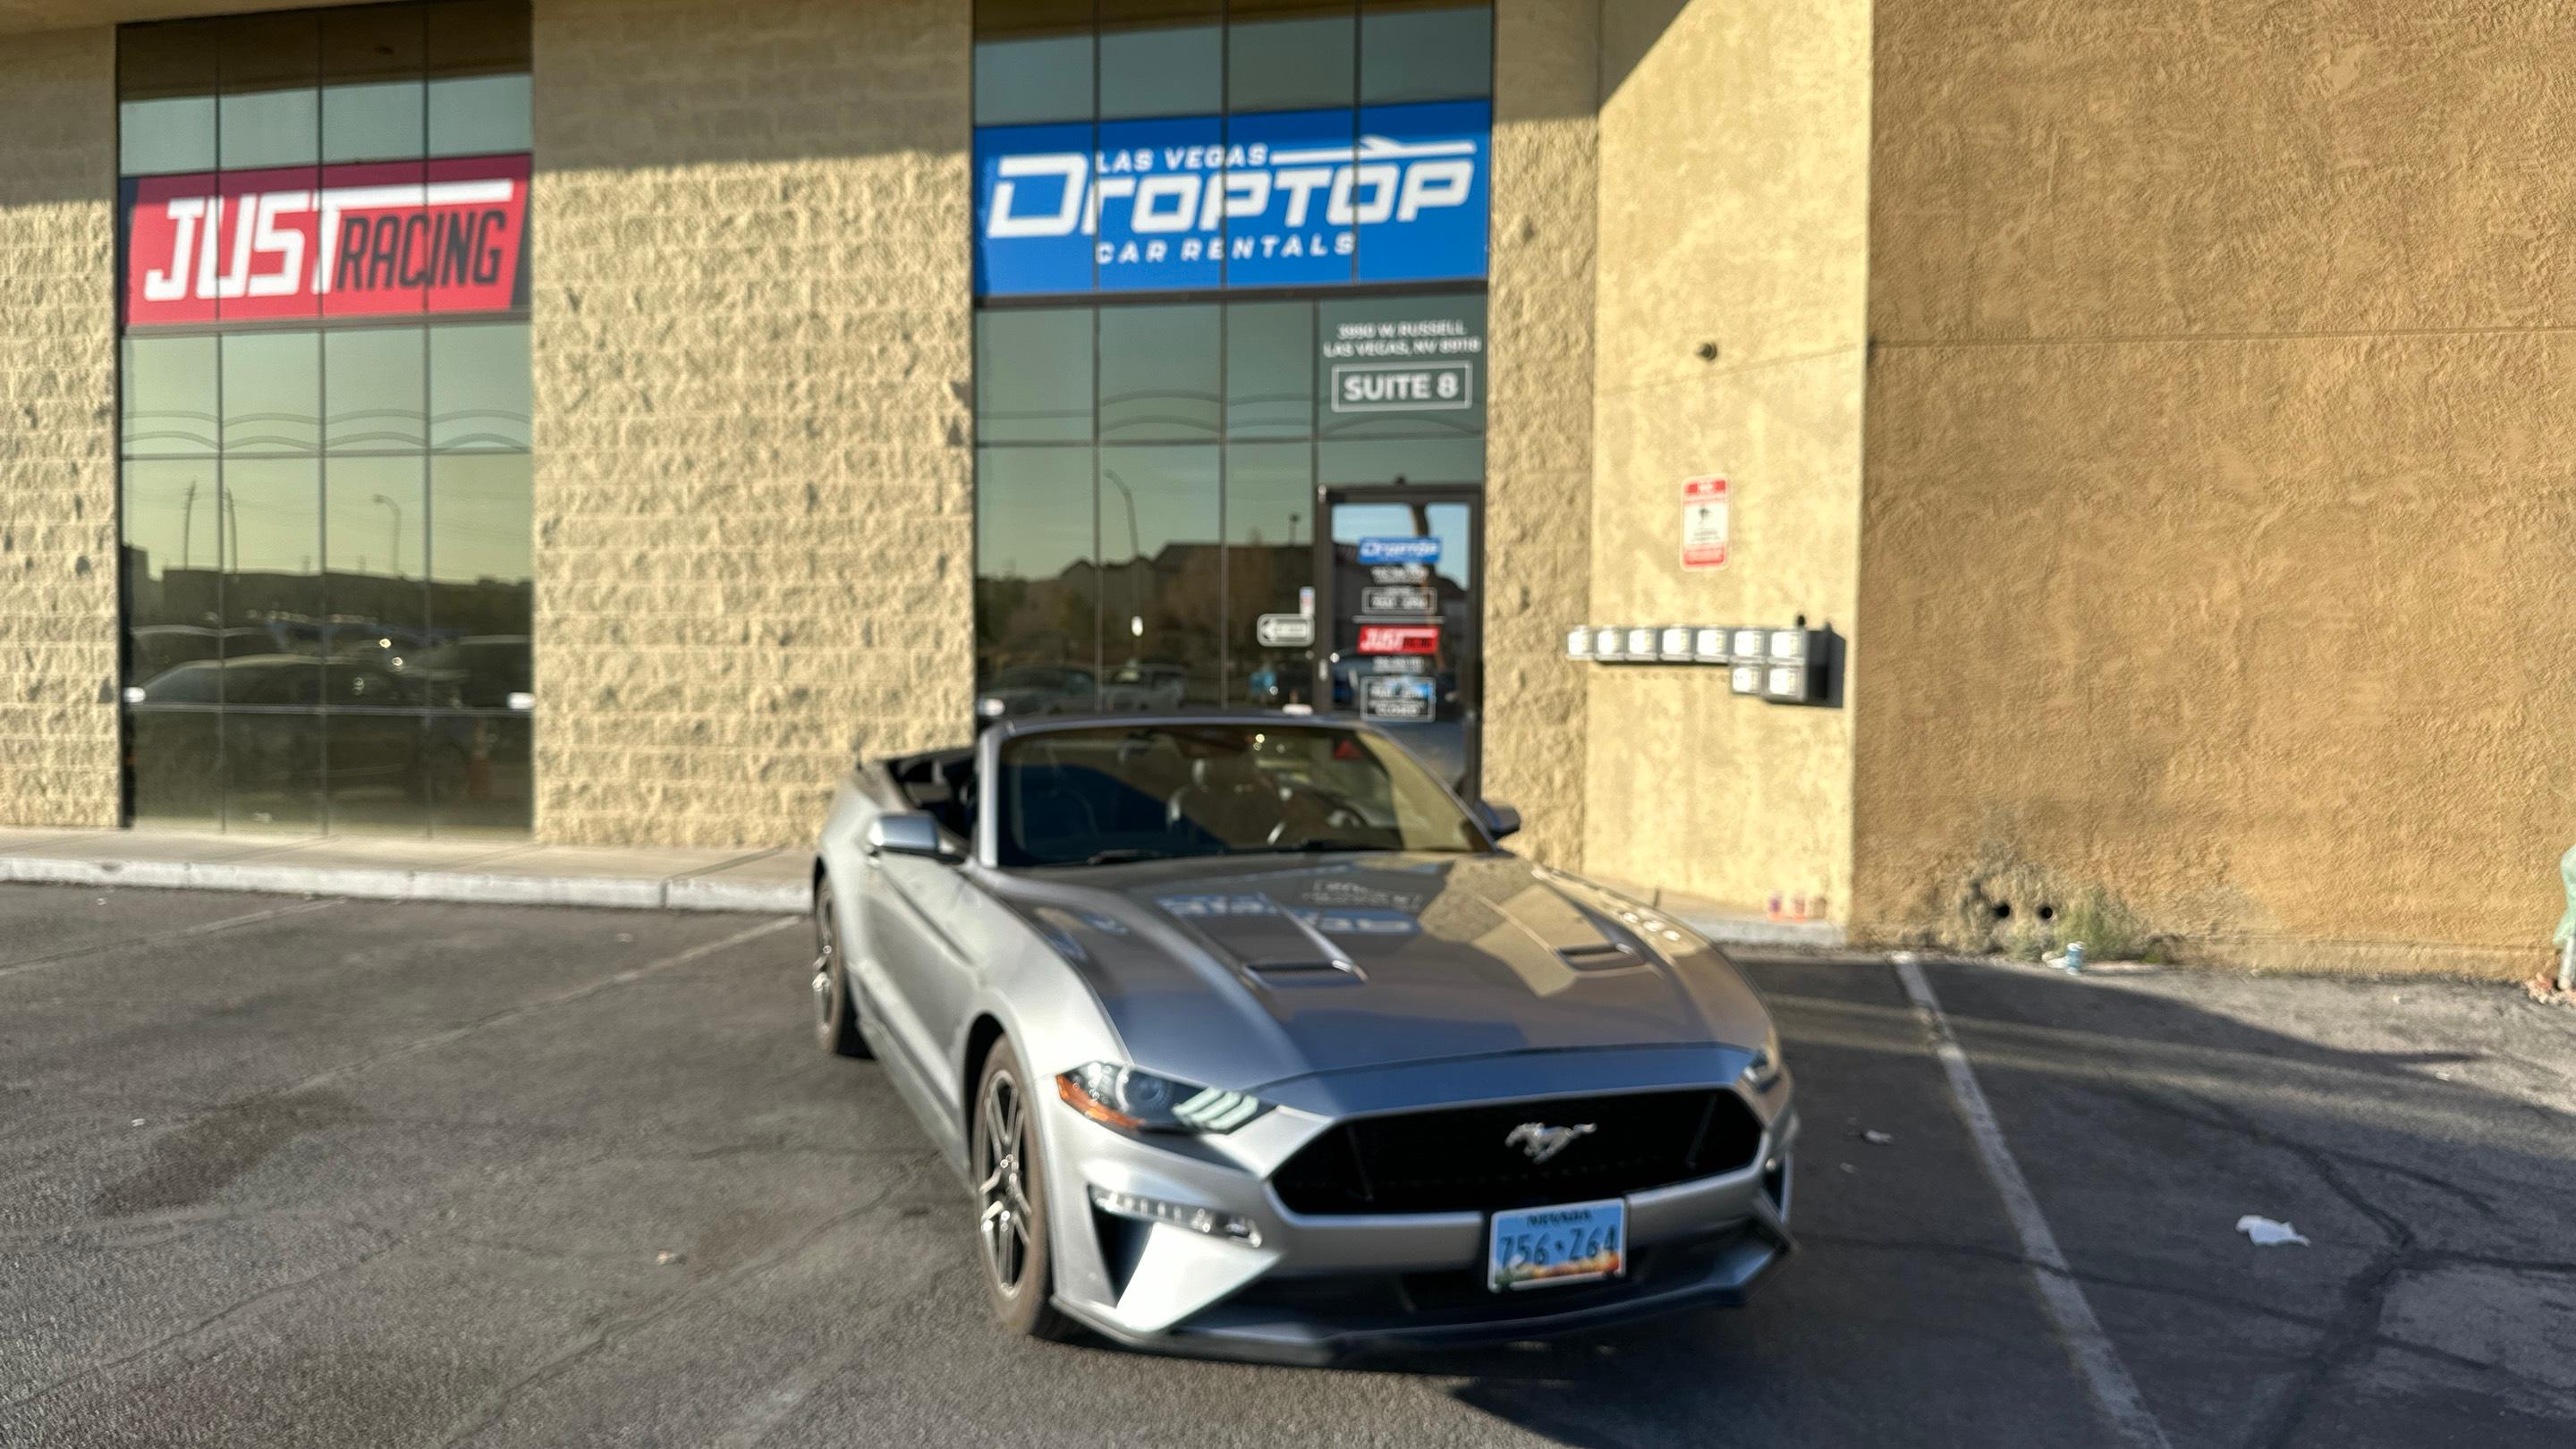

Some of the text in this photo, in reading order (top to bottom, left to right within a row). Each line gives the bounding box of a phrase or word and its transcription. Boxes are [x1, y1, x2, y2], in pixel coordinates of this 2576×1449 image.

[1097, 143, 1269, 174] LAS VEGAS
[336, 209, 506, 292] RACING
[1096, 233, 1357, 266] CAR RENTALS
[1377, 322, 1396, 337] W
[1398, 319, 1466, 336] RUSSELL
[1323, 341, 1355, 357] LAS
[1412, 338, 1438, 354] NV
[1343, 371, 1459, 401] SUITE 8
